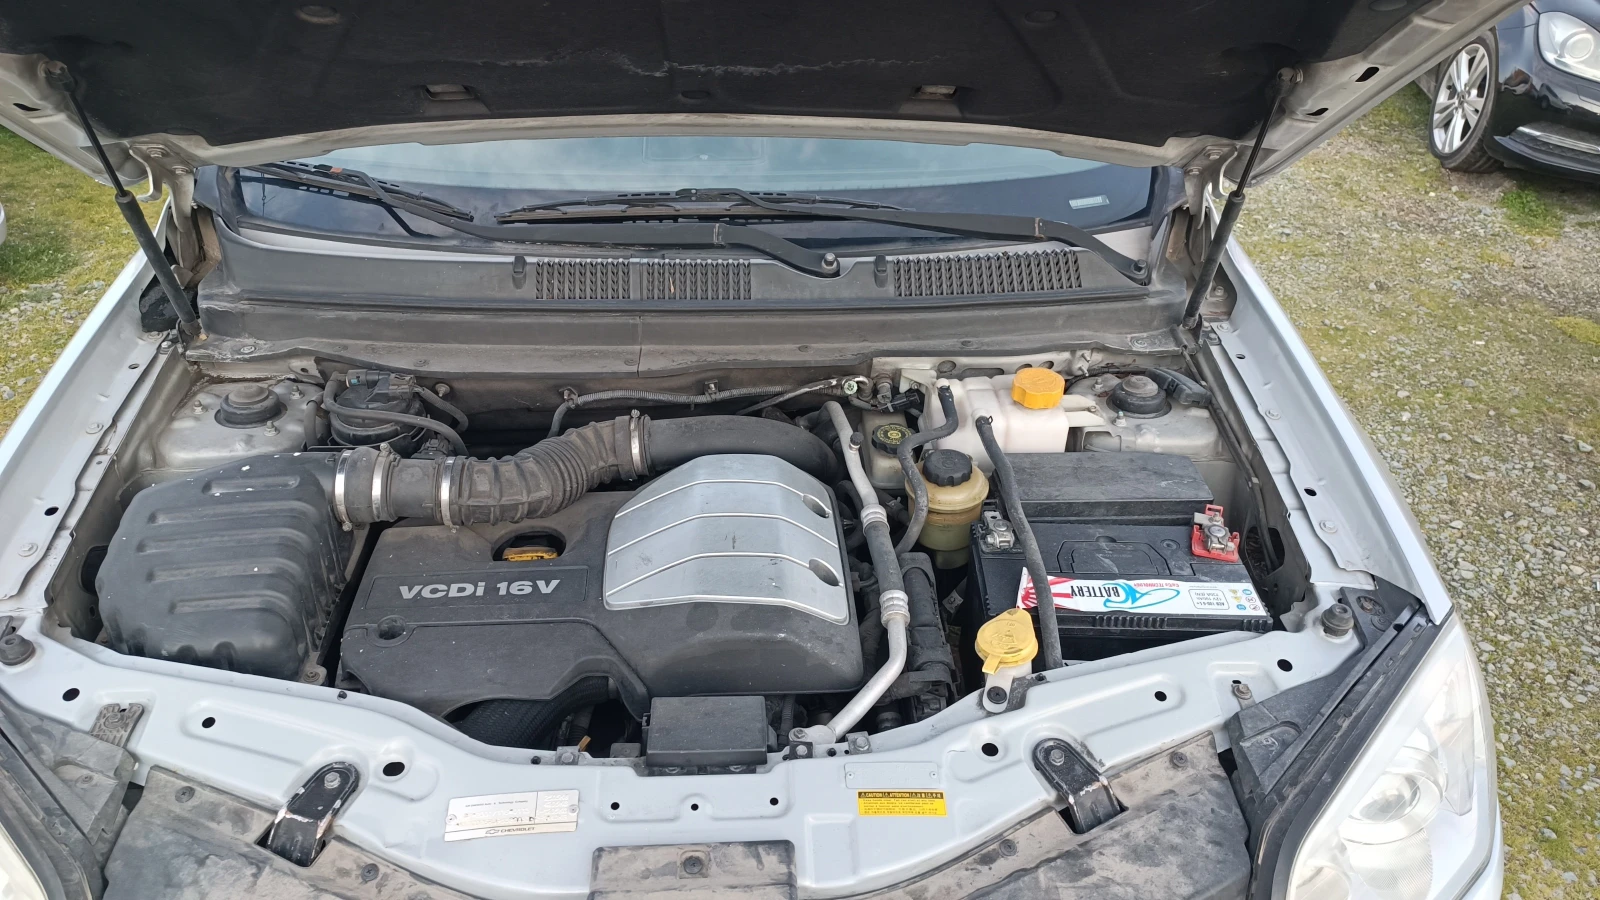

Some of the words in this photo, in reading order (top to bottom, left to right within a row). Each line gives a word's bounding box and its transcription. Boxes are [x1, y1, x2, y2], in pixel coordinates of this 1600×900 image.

[399, 581, 486, 600] VCDi
[496, 579, 561, 596] 16V
[1070, 585, 1121, 598] BATTERY
[500, 826, 535, 834] CHEVROLET
